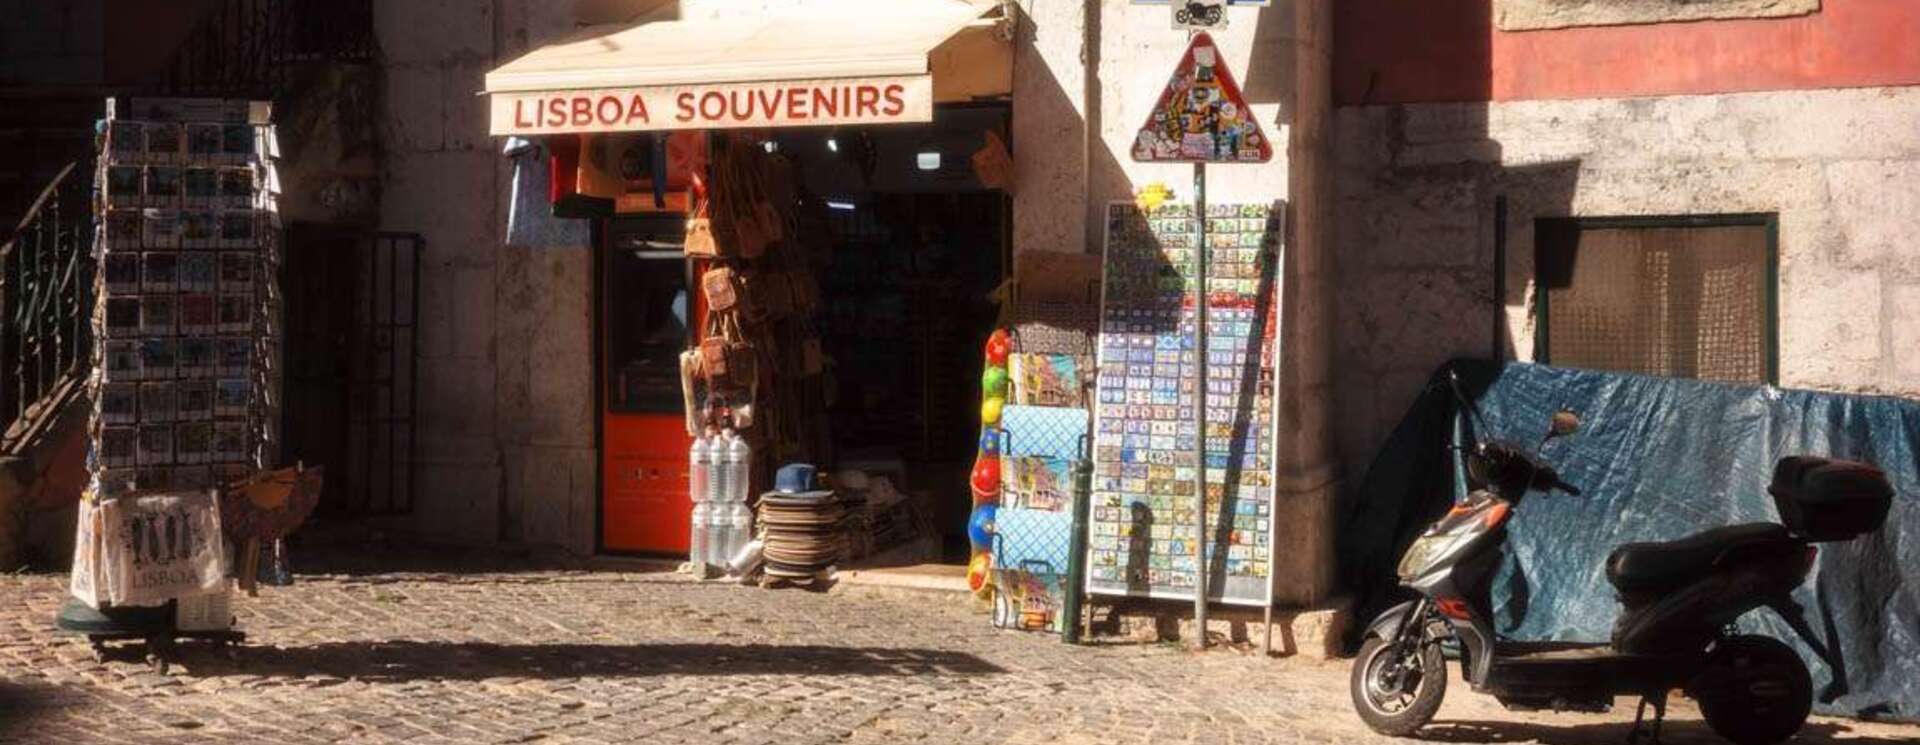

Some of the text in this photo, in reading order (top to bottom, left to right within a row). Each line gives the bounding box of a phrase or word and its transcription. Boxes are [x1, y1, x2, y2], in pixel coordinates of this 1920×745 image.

[514, 84, 905, 129] LISBOA SOUVENIRS
[132, 569, 199, 589] LISBOA
